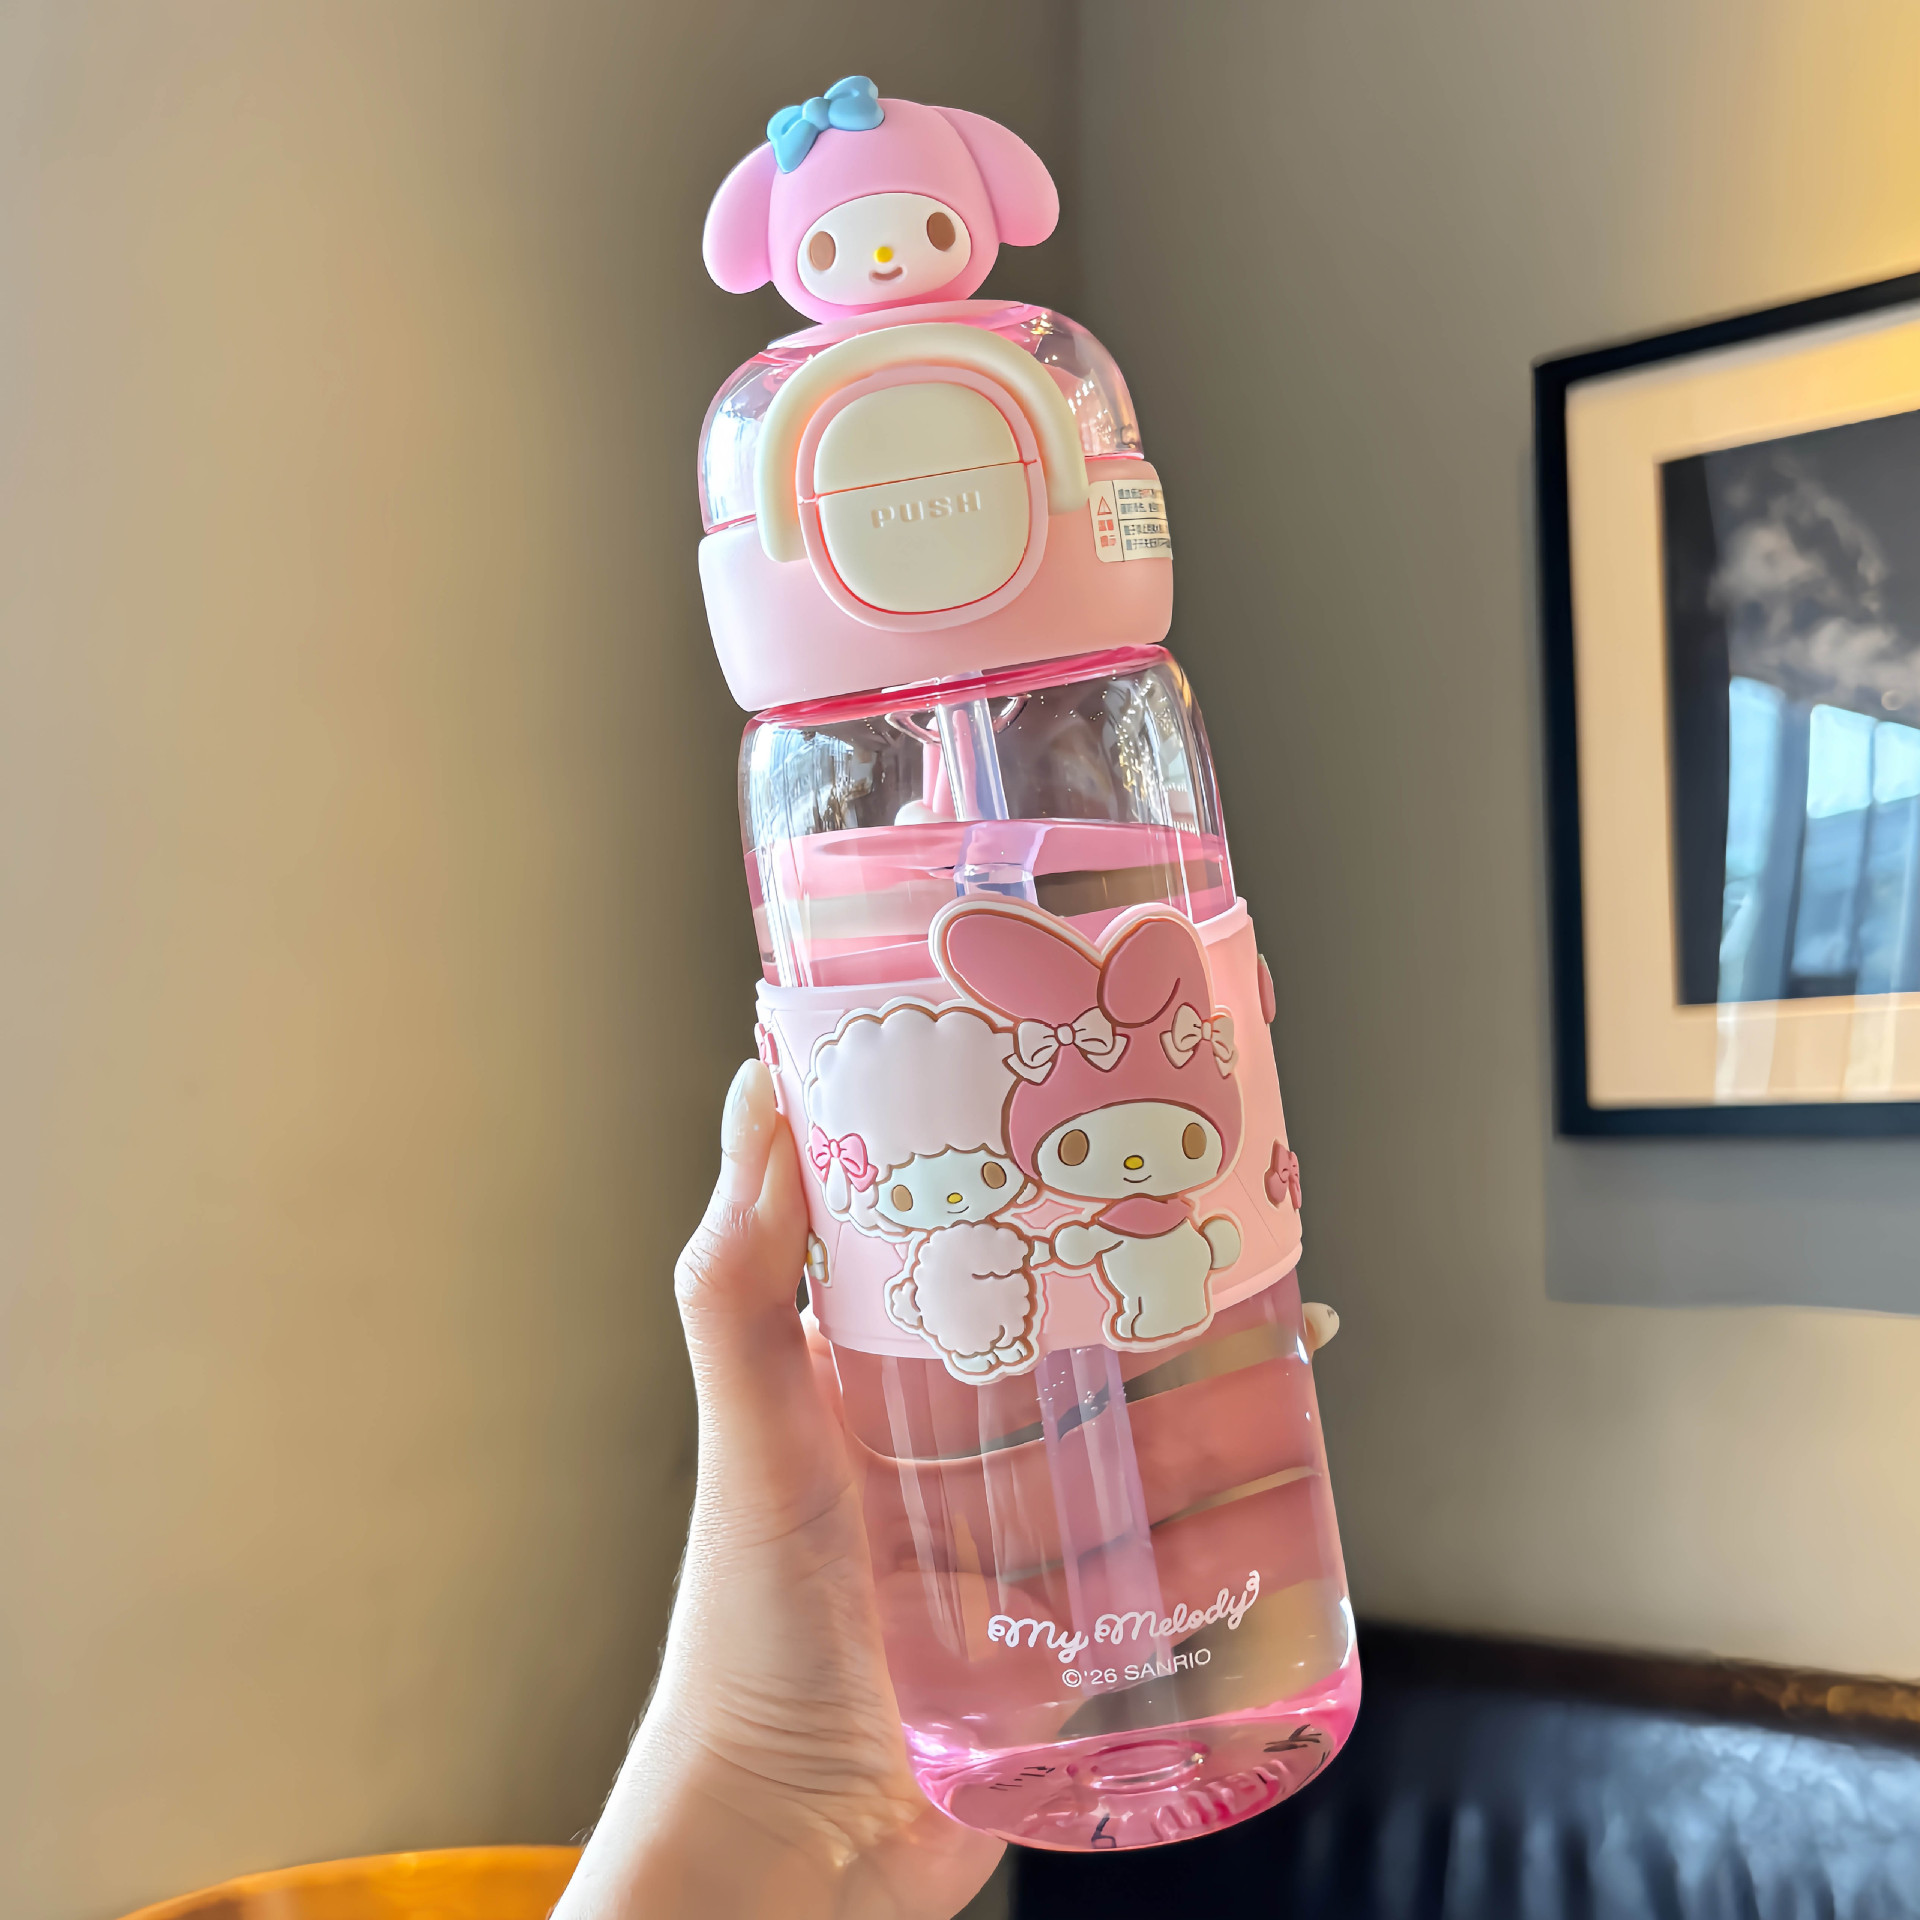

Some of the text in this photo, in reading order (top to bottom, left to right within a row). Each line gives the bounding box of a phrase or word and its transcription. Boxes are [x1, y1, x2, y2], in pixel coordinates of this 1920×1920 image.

[871, 490, 981, 528] PUSH
[987, 1570, 1260, 1663] My Melody
[1124, 1648, 1211, 1681] SANRIO
